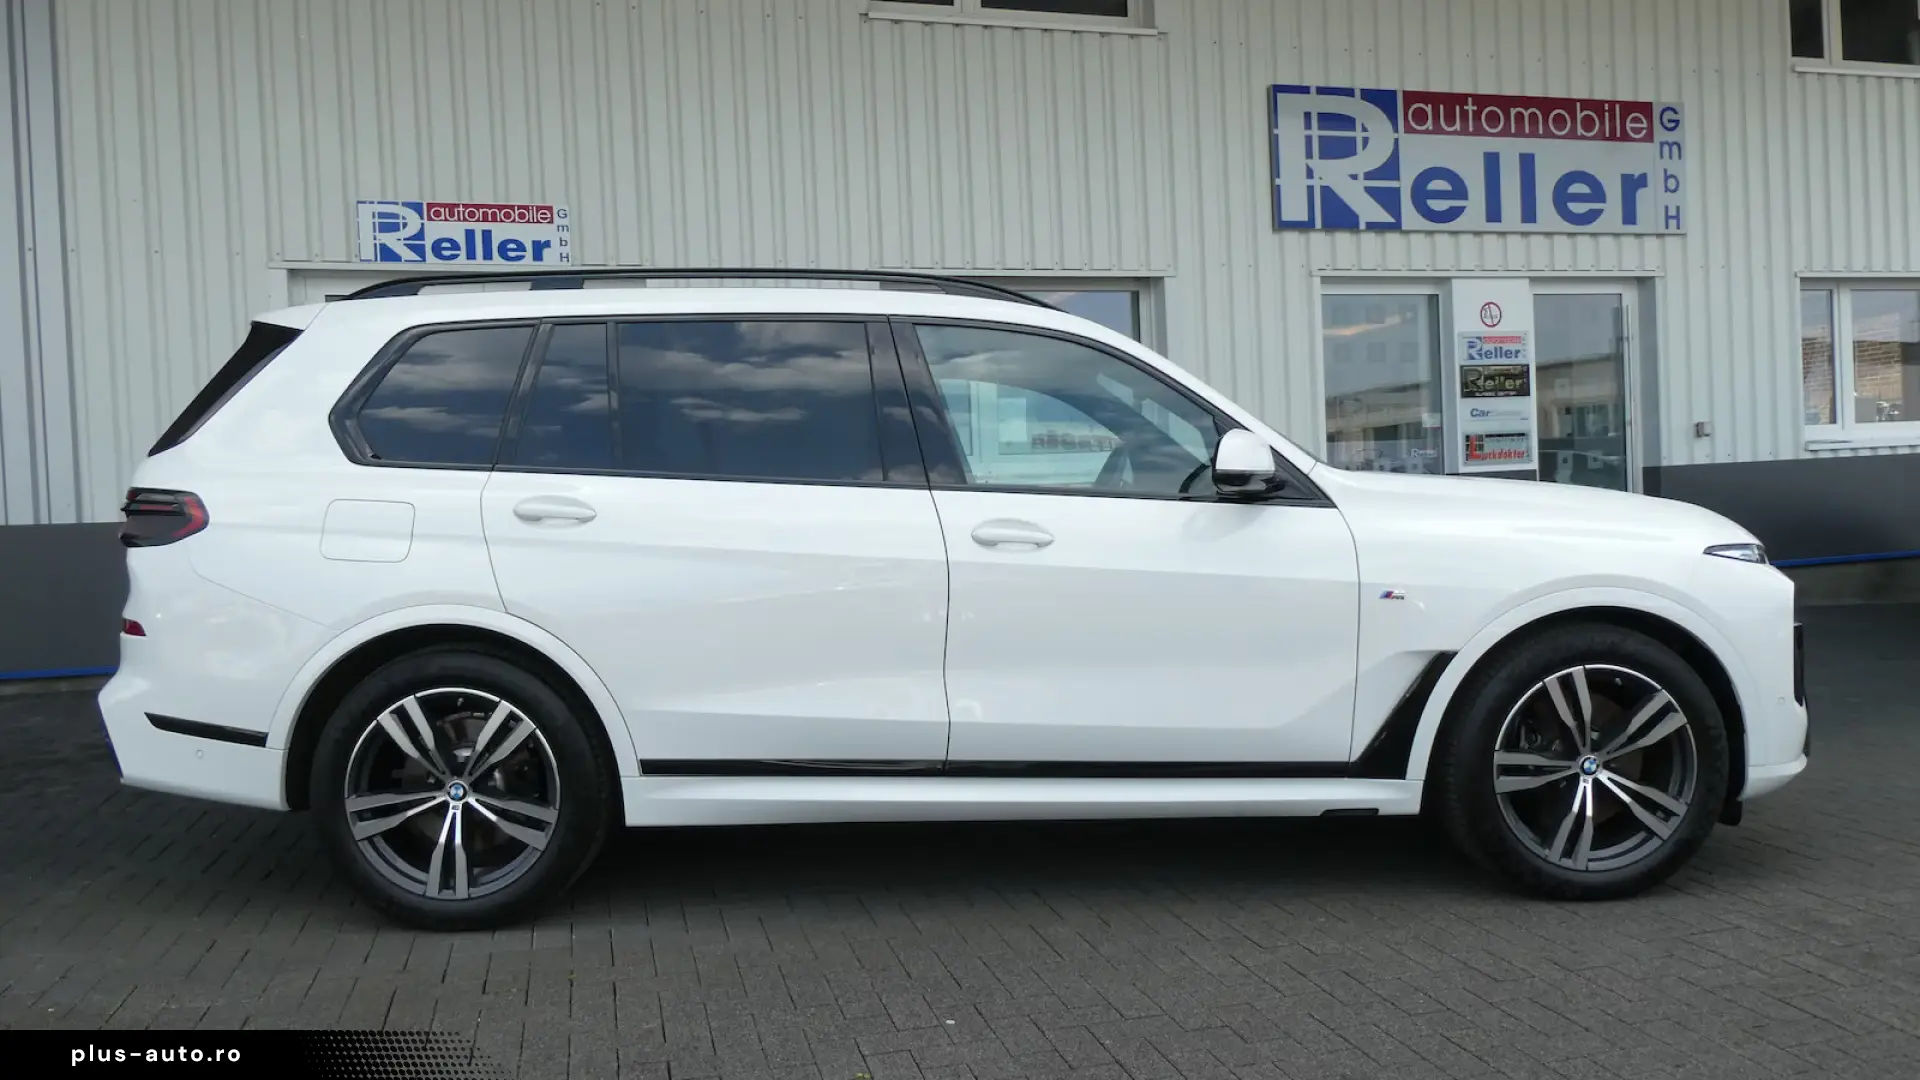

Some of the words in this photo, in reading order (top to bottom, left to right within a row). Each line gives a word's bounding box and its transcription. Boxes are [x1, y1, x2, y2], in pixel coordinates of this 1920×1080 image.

[1407, 97, 1649, 138] automobile
[1276, 92, 1649, 226] Reller
[1658, 106, 1682, 230] GmbH
[357, 203, 552, 263] Reller
[430, 204, 552, 223] automobile
[557, 208, 571, 263] GmbH
[1465, 337, 1521, 360] Reller
